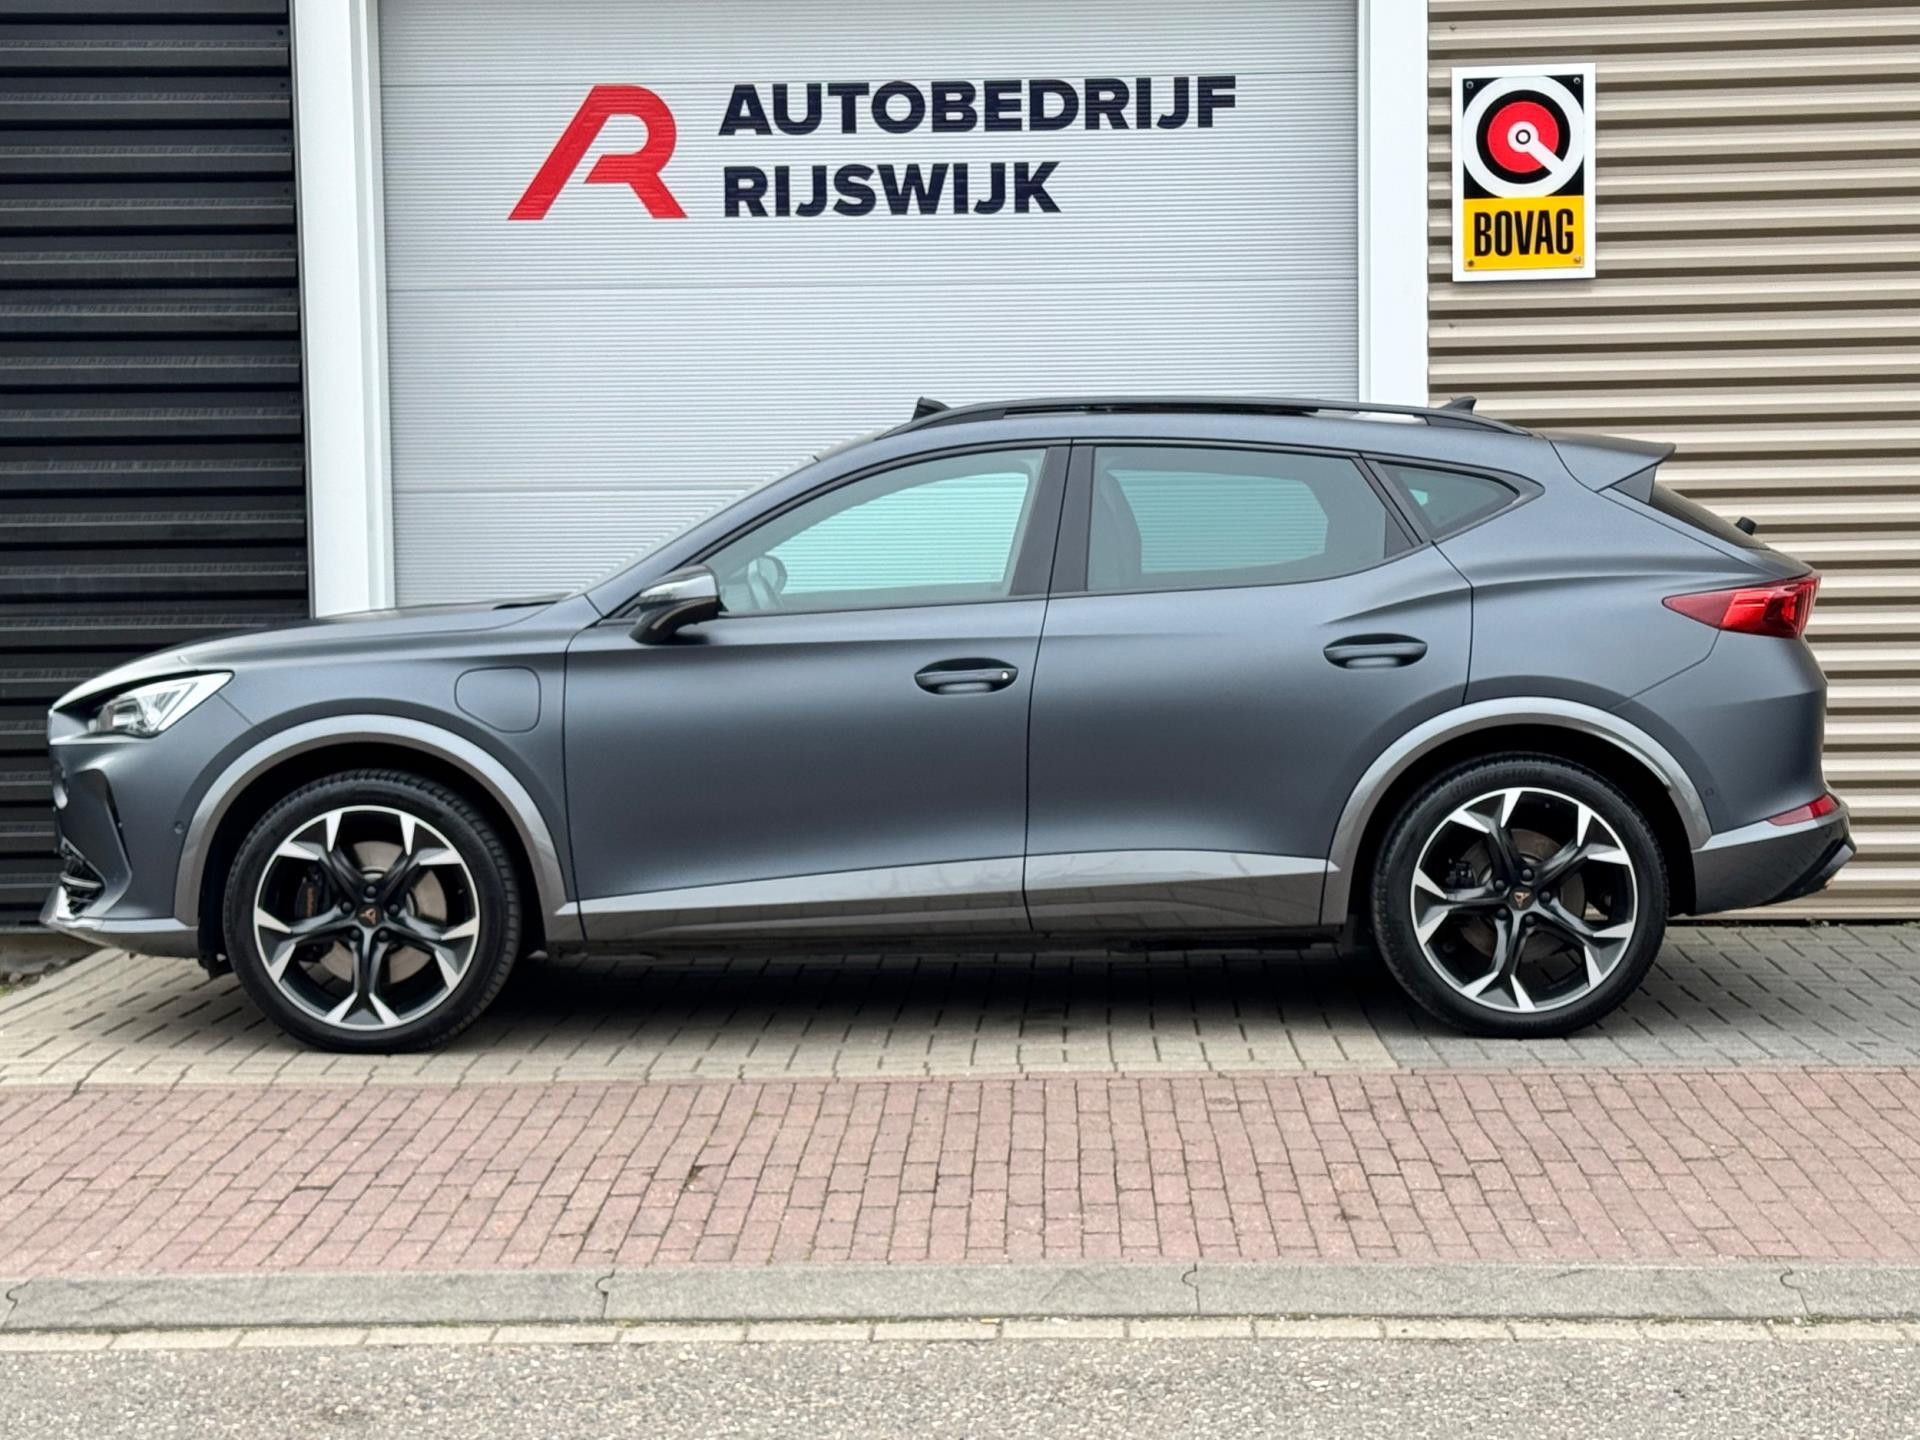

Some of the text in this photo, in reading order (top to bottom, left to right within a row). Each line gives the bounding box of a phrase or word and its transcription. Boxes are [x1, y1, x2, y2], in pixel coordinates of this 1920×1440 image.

[718, 75, 1237, 136] AUTOBEDRIJF
[723, 161, 1062, 218] RIJSWIJK
[1474, 208, 1574, 257] BOVAG
